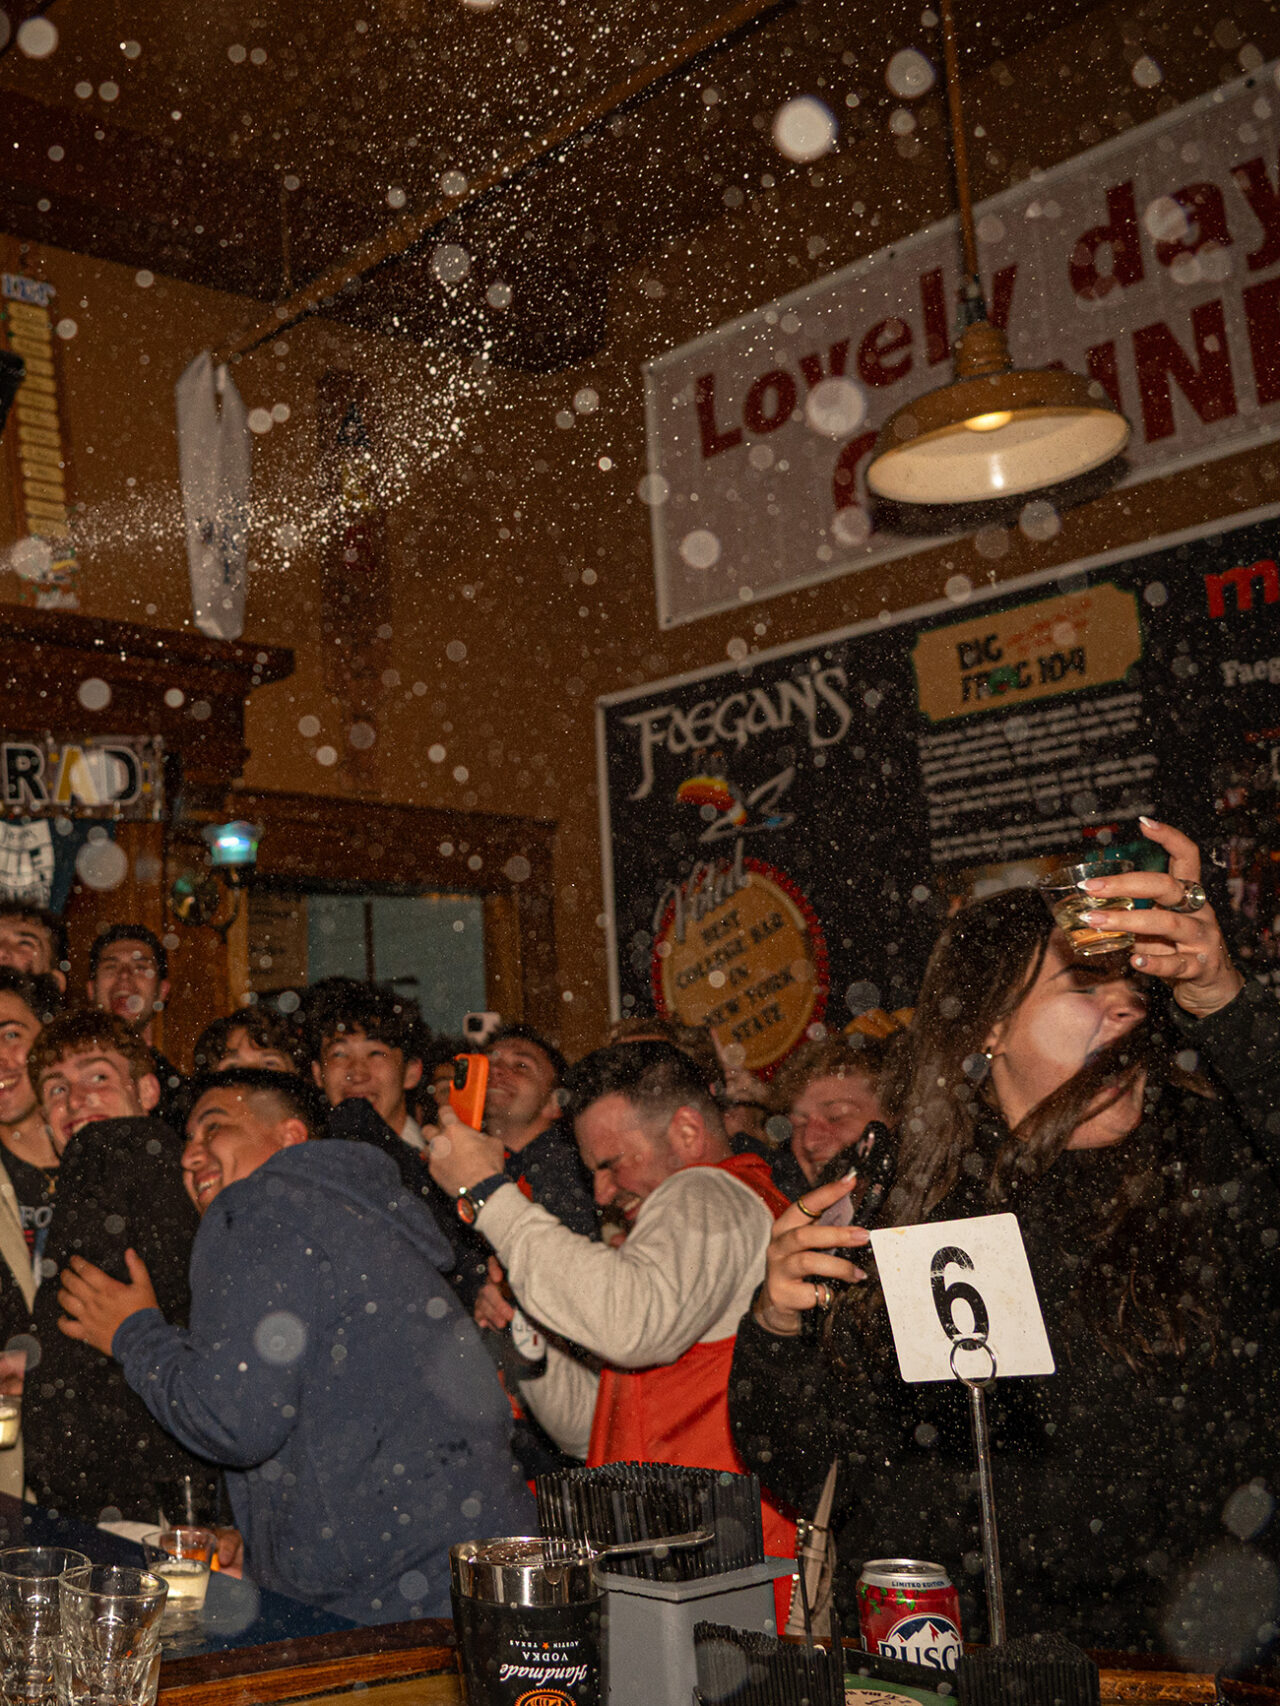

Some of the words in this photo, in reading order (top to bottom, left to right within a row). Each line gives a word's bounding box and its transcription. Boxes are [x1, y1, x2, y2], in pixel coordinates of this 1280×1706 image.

[956, 634, 1003, 671] BIG
[1038, 645, 1088, 684] 104
[700, 910, 743, 944] BEST
[674, 934, 749, 990] COLLEGE
[747, 911, 785, 951] BAR
[728, 965, 750, 991] IN
[704, 992, 749, 1028] NEW
[744, 964, 797, 1006] YORK
[730, 1004, 787, 1044] STATE
[929, 1245, 991, 1351] 6
[891, 1580, 922, 1588] LIMITED
[922, 1580, 946, 1588] EDITION
[508, 1640, 539, 1649] TEXAS
[521, 1651, 569, 1662] VODKA
[552, 1640, 580, 1649] AUSTIN
[499, 1664, 589, 1687] Handmade
